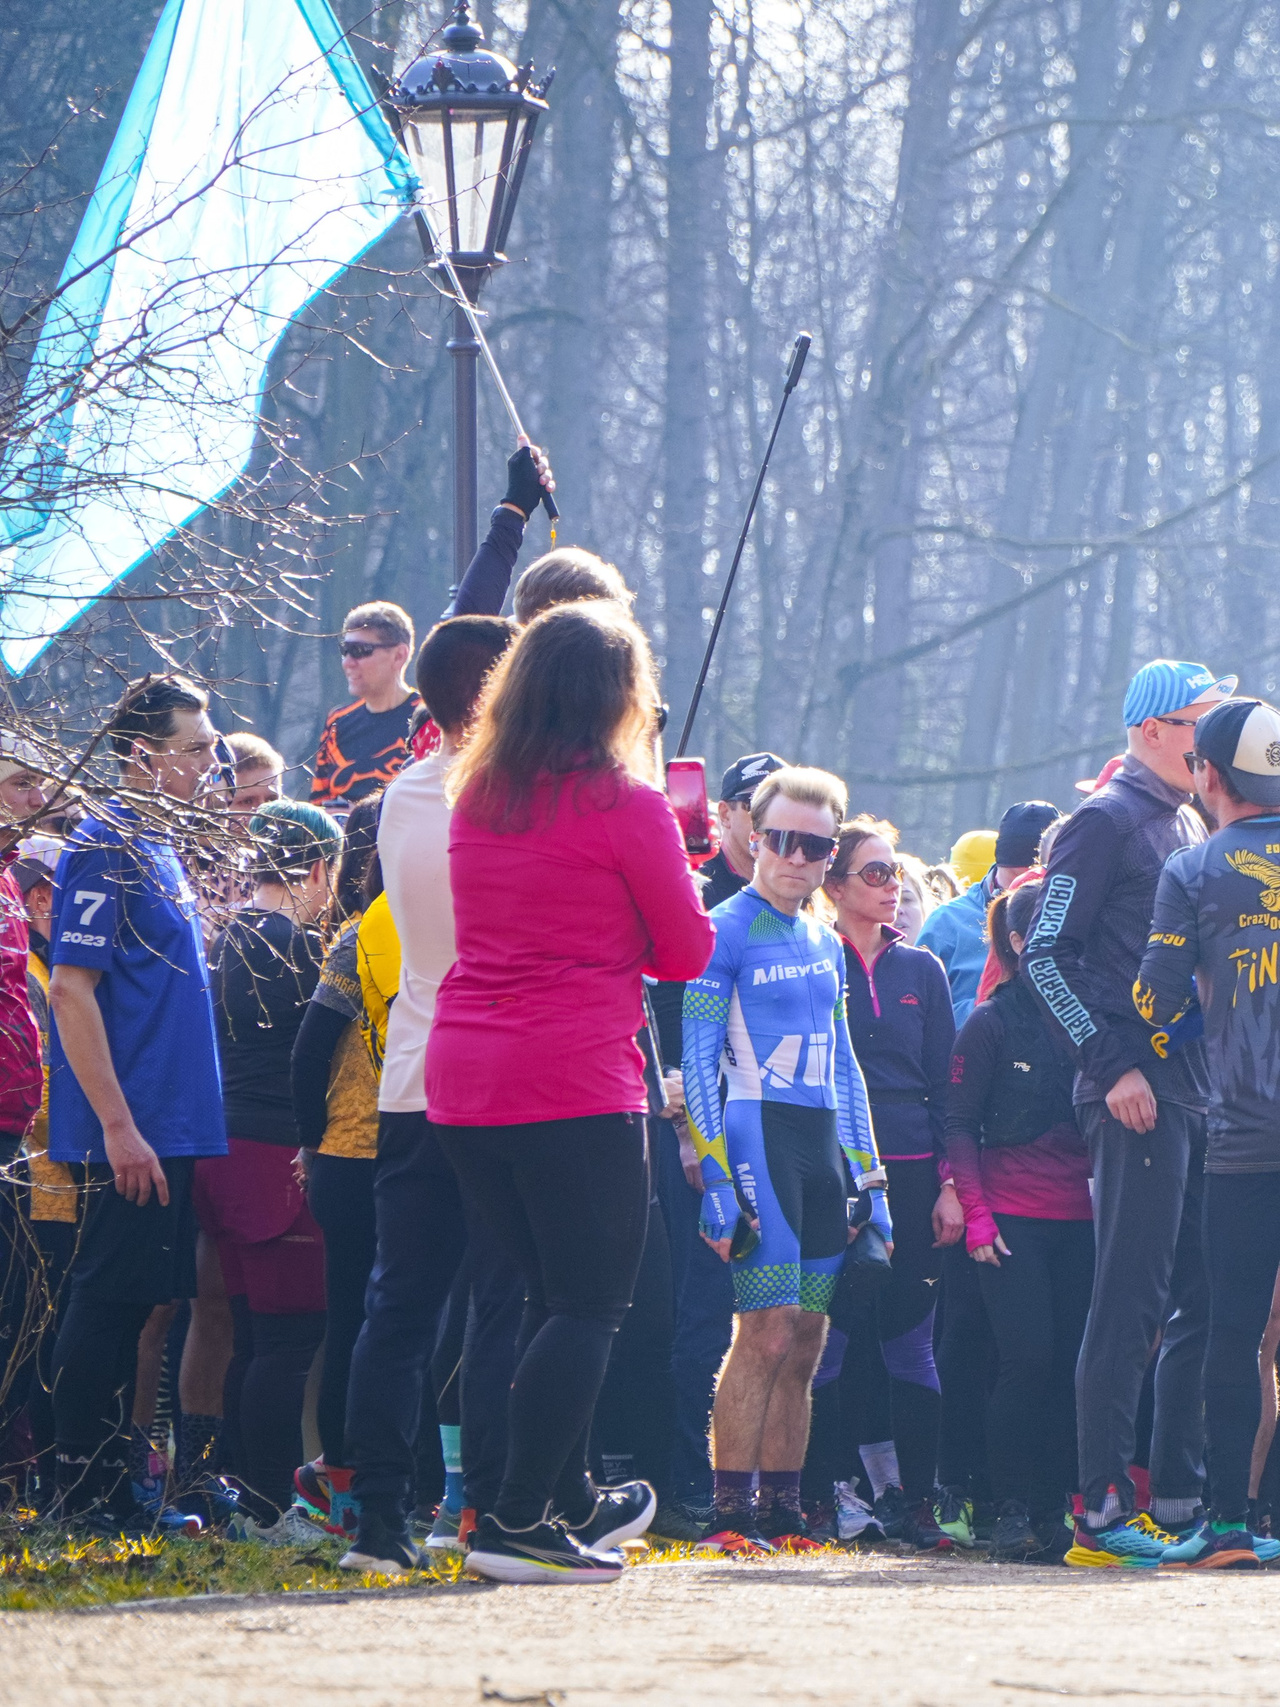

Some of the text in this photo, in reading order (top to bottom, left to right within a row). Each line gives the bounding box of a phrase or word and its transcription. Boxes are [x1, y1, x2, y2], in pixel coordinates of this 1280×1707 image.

[74, 890, 107, 926] 7
[60, 931, 106, 947] 2023
[752, 958, 833, 986] Mieyco
[1028, 957, 1097, 1047] КАПИБАРА
[710, 1192, 726, 1227] Mieyco
